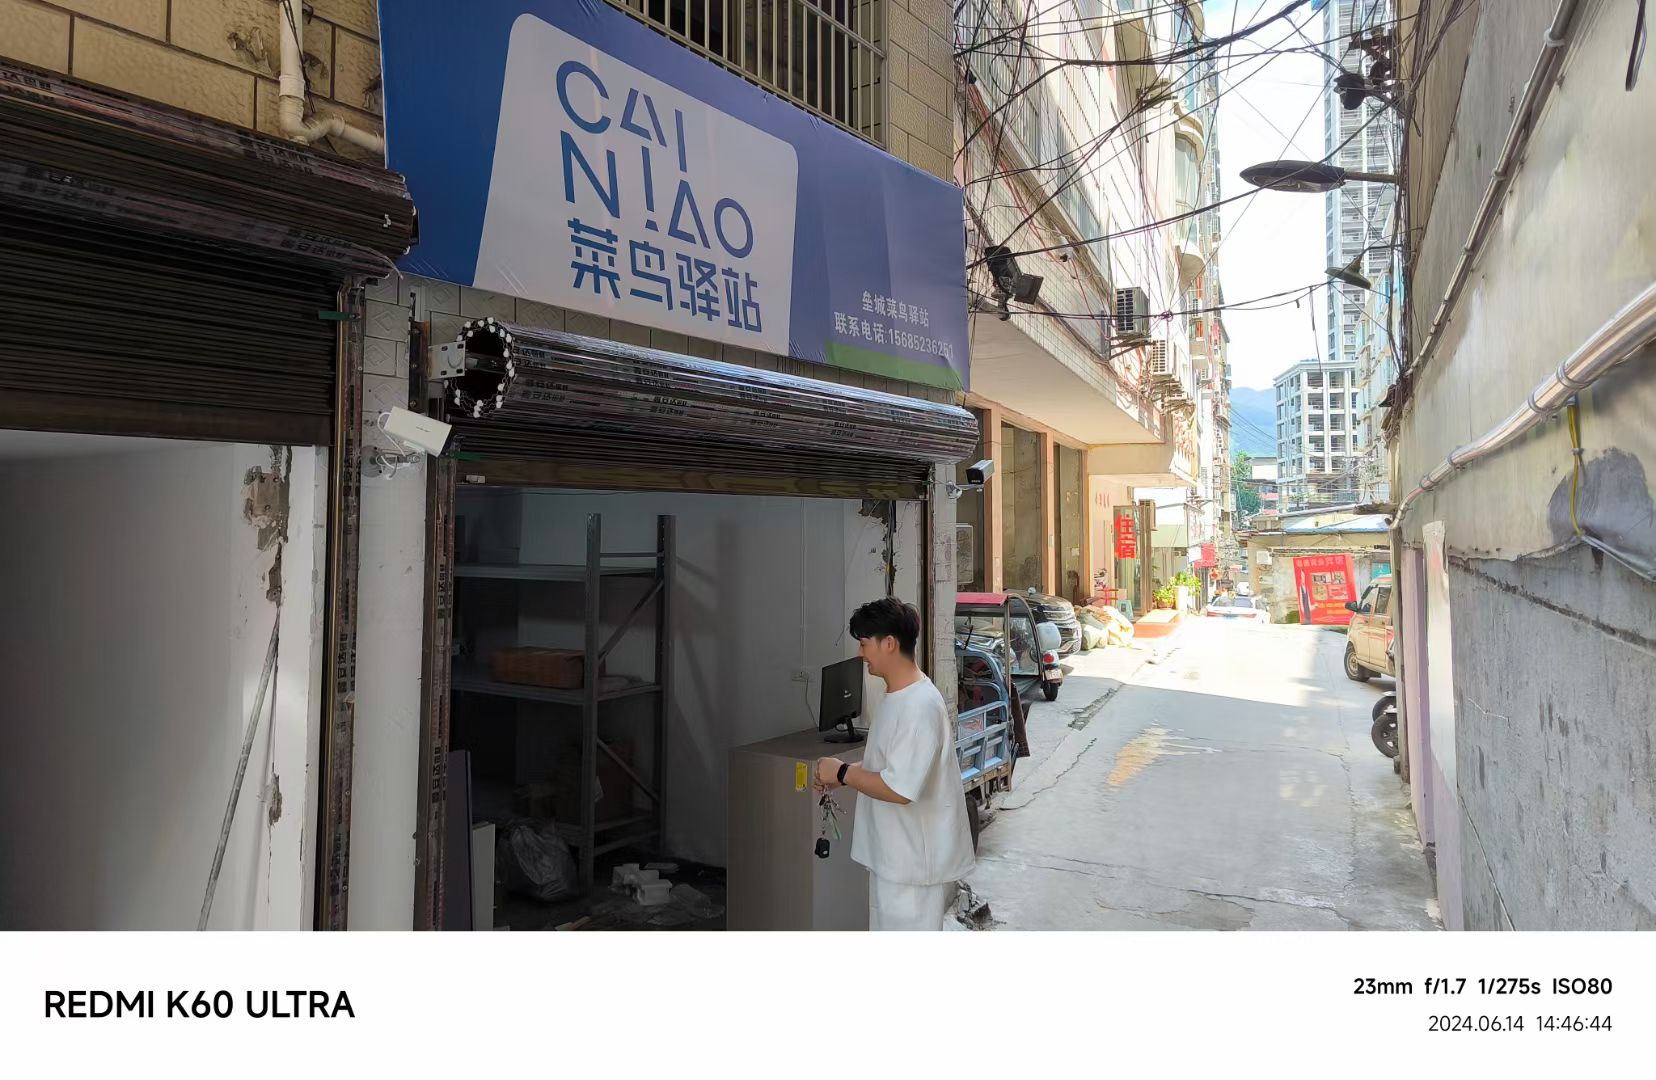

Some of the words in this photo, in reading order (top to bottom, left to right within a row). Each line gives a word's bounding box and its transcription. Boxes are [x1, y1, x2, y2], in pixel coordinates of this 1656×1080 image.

[555, 60, 688, 173] CAI
[567, 217, 762, 333] 菜鸟驿站
[1114, 513, 1136, 560] 住宿
